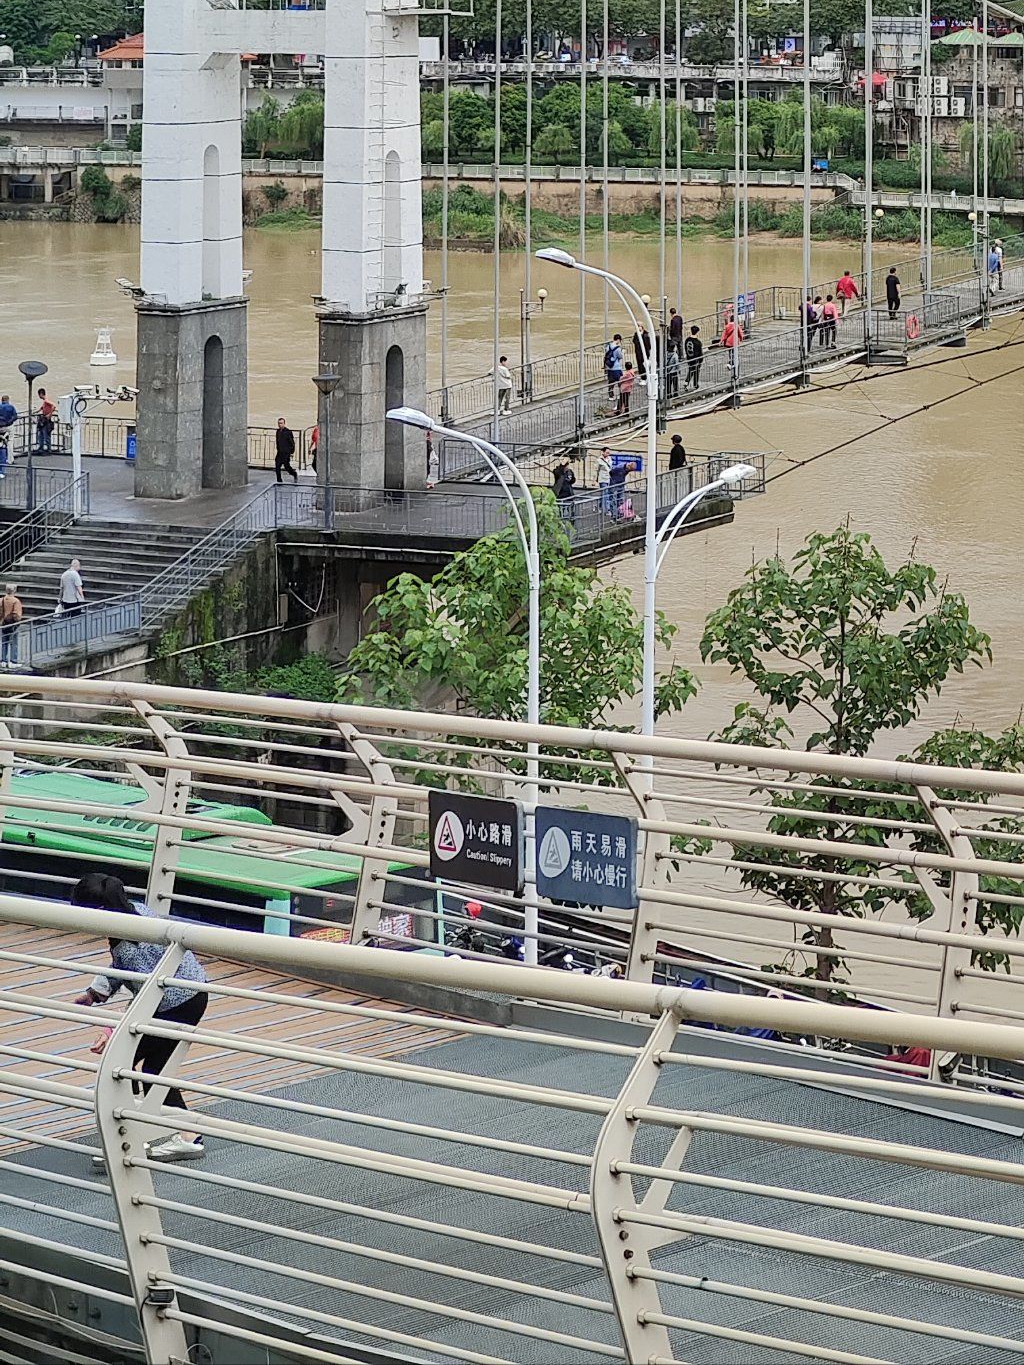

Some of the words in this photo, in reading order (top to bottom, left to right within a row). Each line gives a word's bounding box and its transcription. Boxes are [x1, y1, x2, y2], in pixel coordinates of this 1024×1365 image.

[466, 818, 512, 847] 小心路滑
[570, 829, 627, 859] 雨天易滑
[466, 848, 489, 862] Caution!
[489, 852, 512, 868] Slippery
[570, 858, 627, 889] 请小心慢行
